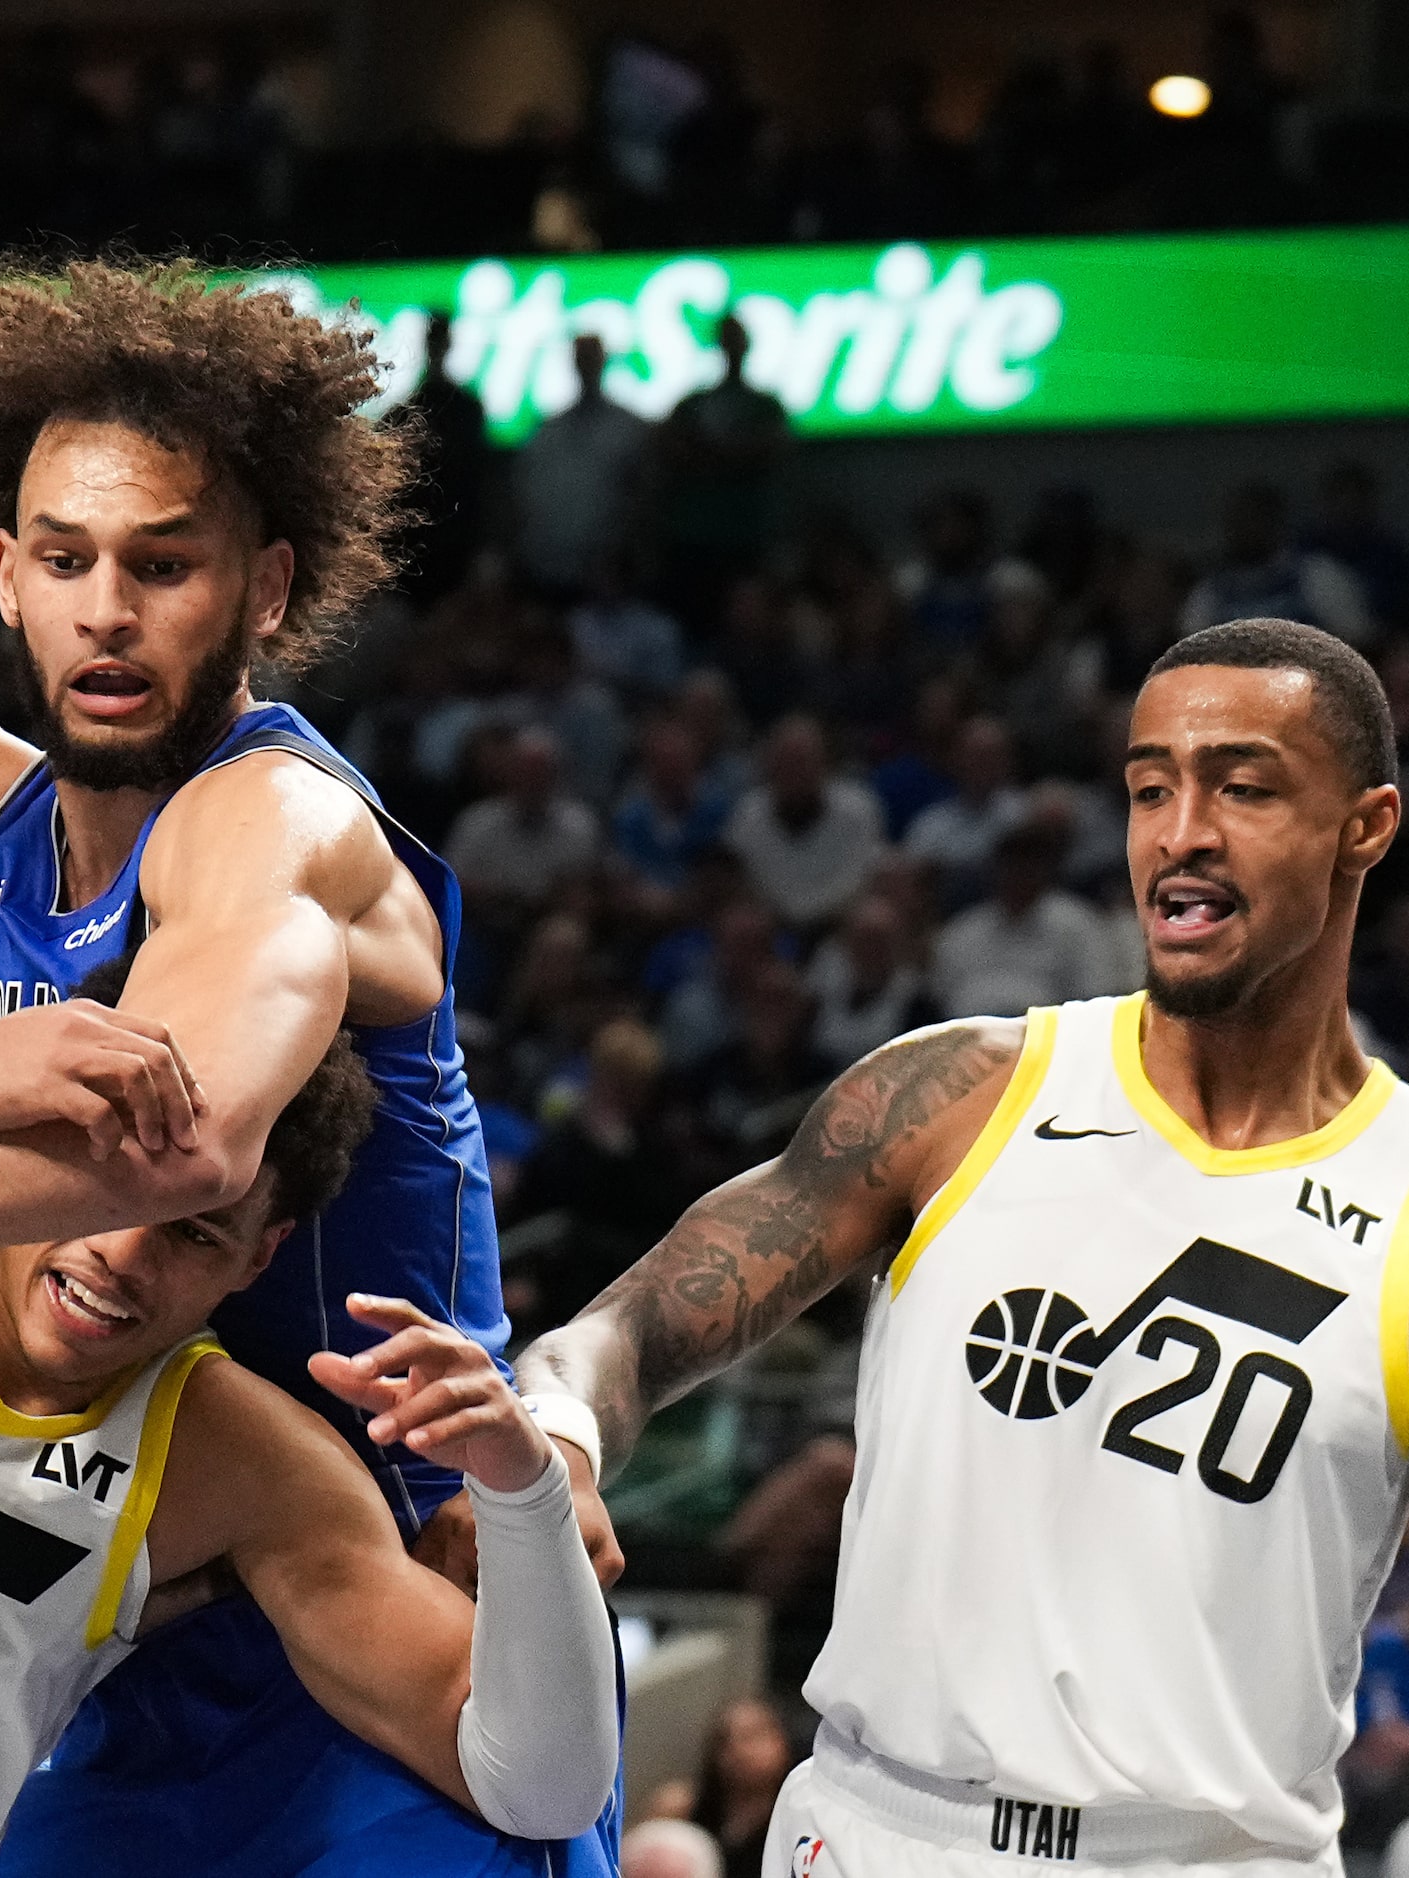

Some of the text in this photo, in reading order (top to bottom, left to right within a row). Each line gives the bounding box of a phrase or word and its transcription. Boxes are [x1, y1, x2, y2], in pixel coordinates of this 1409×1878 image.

[1296, 1176, 1383, 1246] LVT
[1101, 1315, 1313, 1504] 20
[31, 1442, 131, 1503] LVT
[991, 1797, 1081, 1861] UTAH
